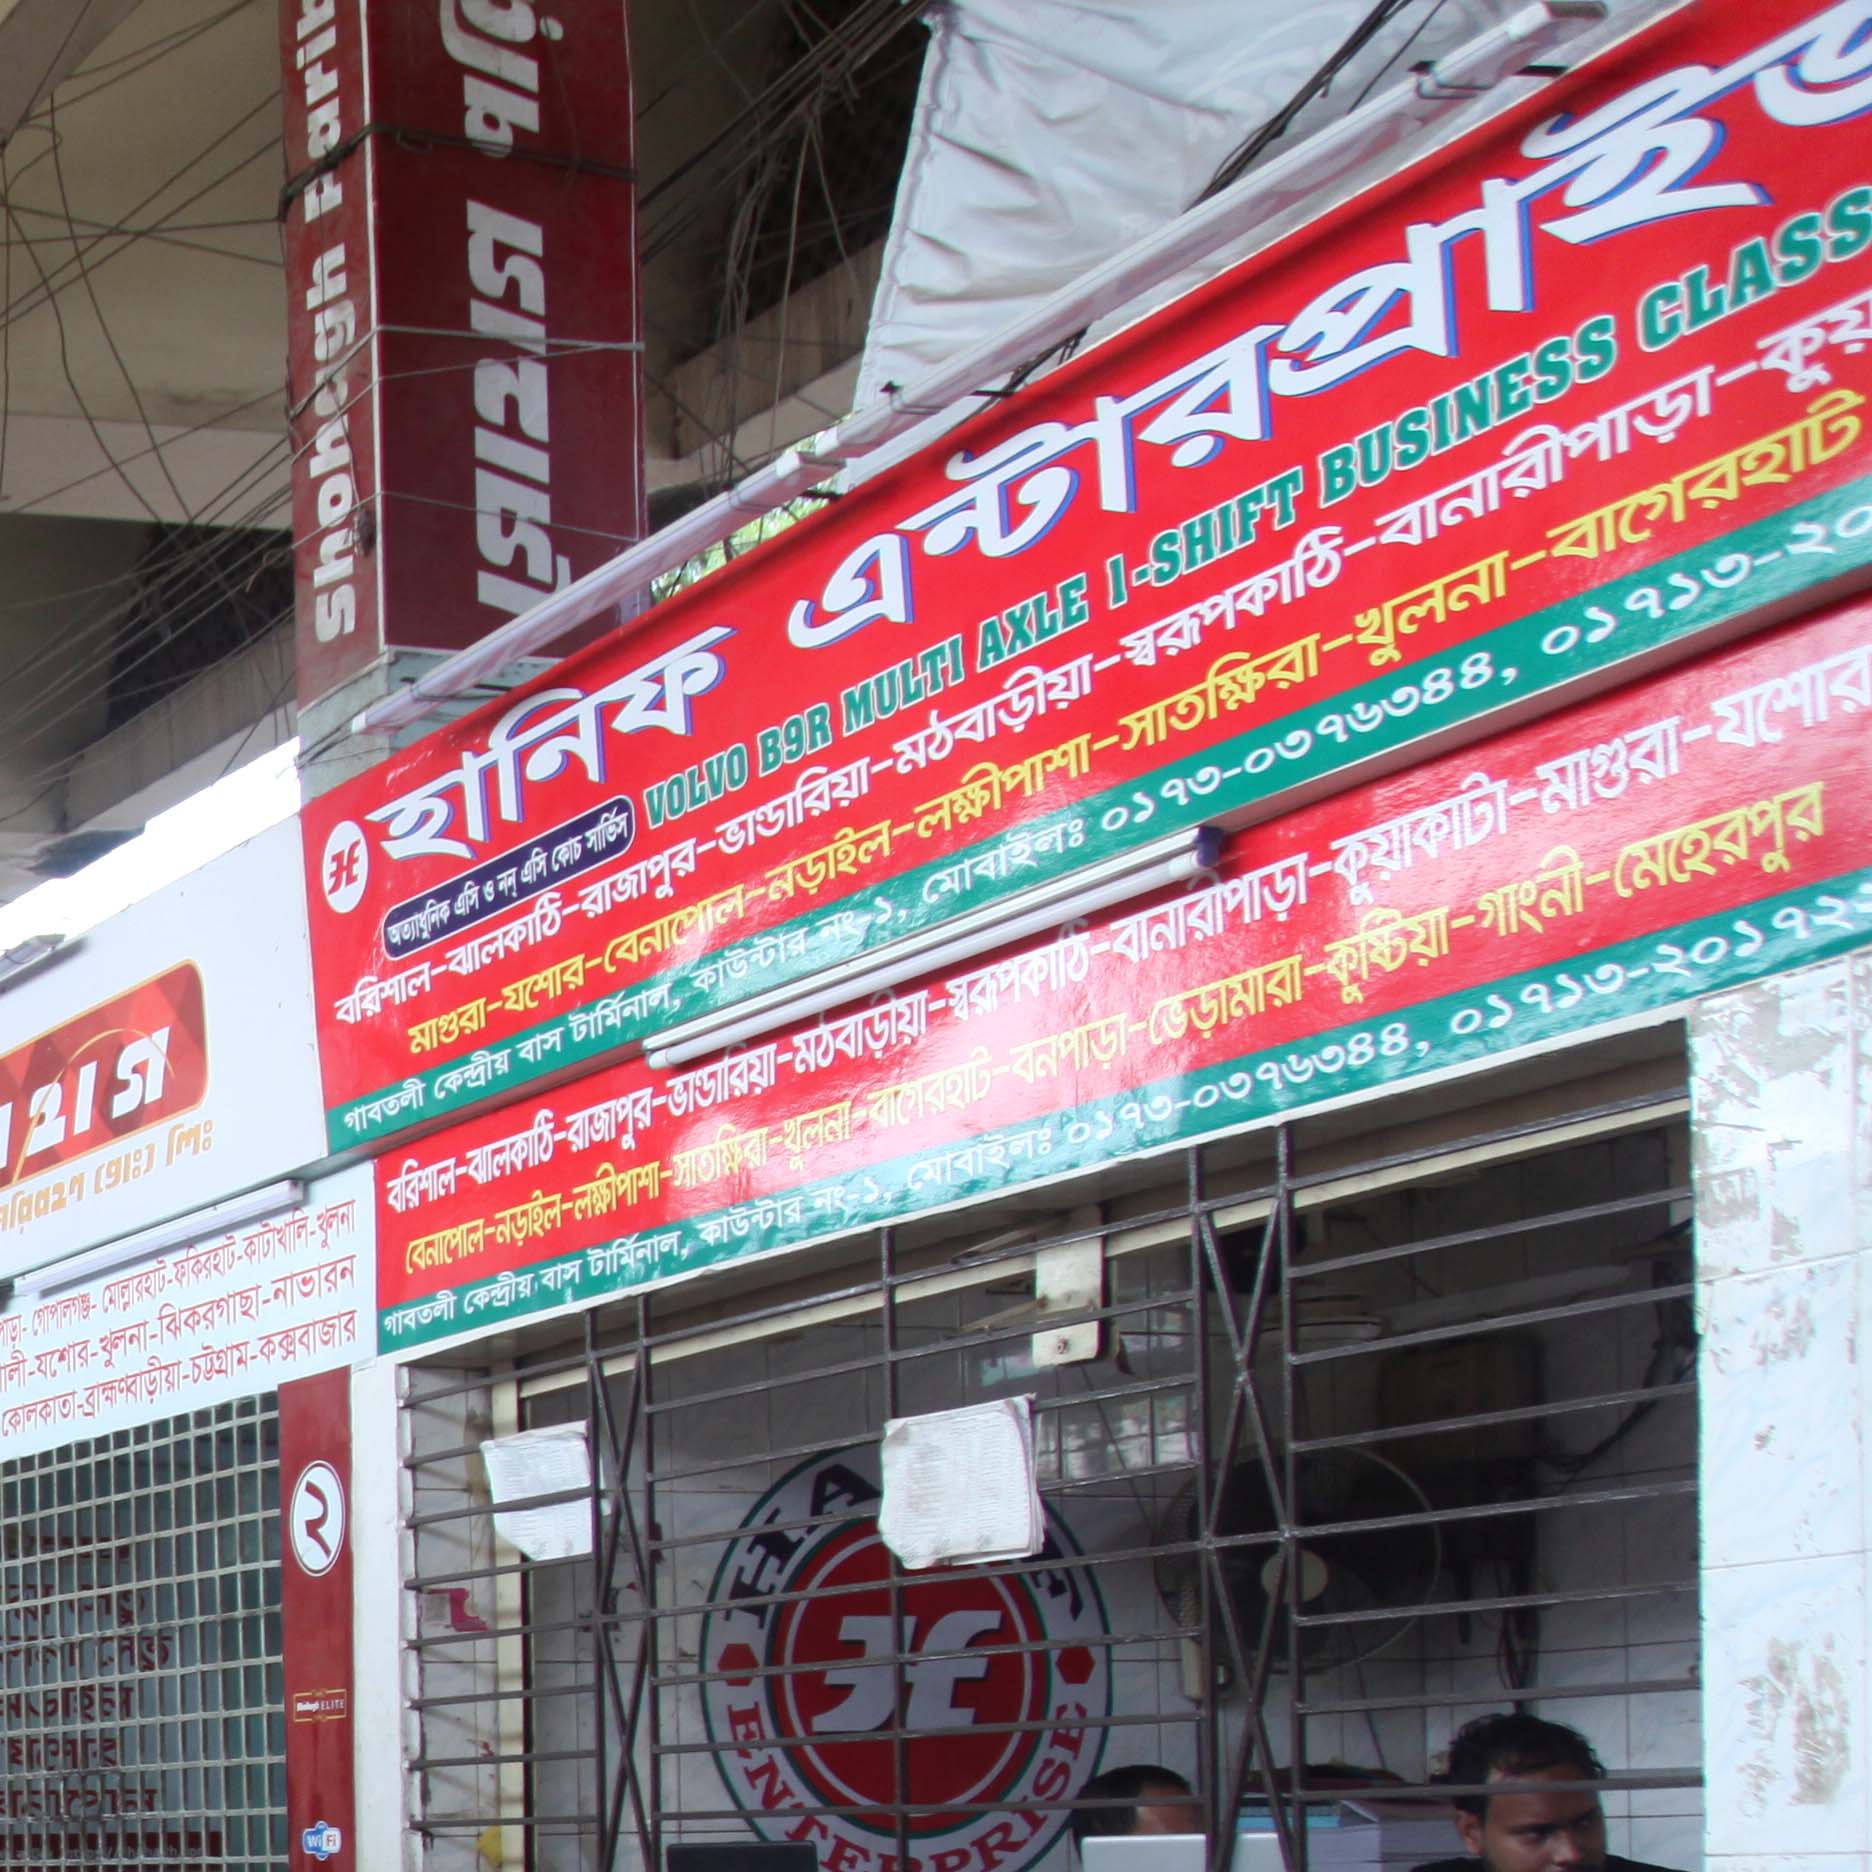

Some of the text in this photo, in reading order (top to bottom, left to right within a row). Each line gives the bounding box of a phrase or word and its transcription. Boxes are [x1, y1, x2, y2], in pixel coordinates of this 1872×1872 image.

[306, 242, 358, 641] Shohagh
[466, 200, 572, 616] সোহাগ
[645, 744, 750, 828] VOLVO
[757, 709, 832, 776] B9R
[843, 633, 965, 731] MULTI
[978, 575, 1091, 673] AXLE
[1318, 313, 1619, 508] BUSINESS
[365, 626, 736, 862] হানিফ
[551, 843, 582, 878] কোচ
[584, 813, 631, 869] সার্ভিস
[343, 1085, 425, 1137] গাবতলী
[432, 1049, 511, 1109] কেন্দ্রীয়
[517, 1028, 562, 1068] বাস
[568, 980, 681, 1051] টার্মিনাল,
[691, 925, 810, 1003] কাউন্টার
[382, 1286, 457, 1336] গাবতলী
[463, 1262, 537, 1315] কেন্দ্রীয়
[542, 1255, 581, 1291] বাস
[586, 1224, 693, 1288] টার্মিনাল,
[700, 1183, 803, 1254] কাউন্টার
[301, 1478, 336, 1540] ২
